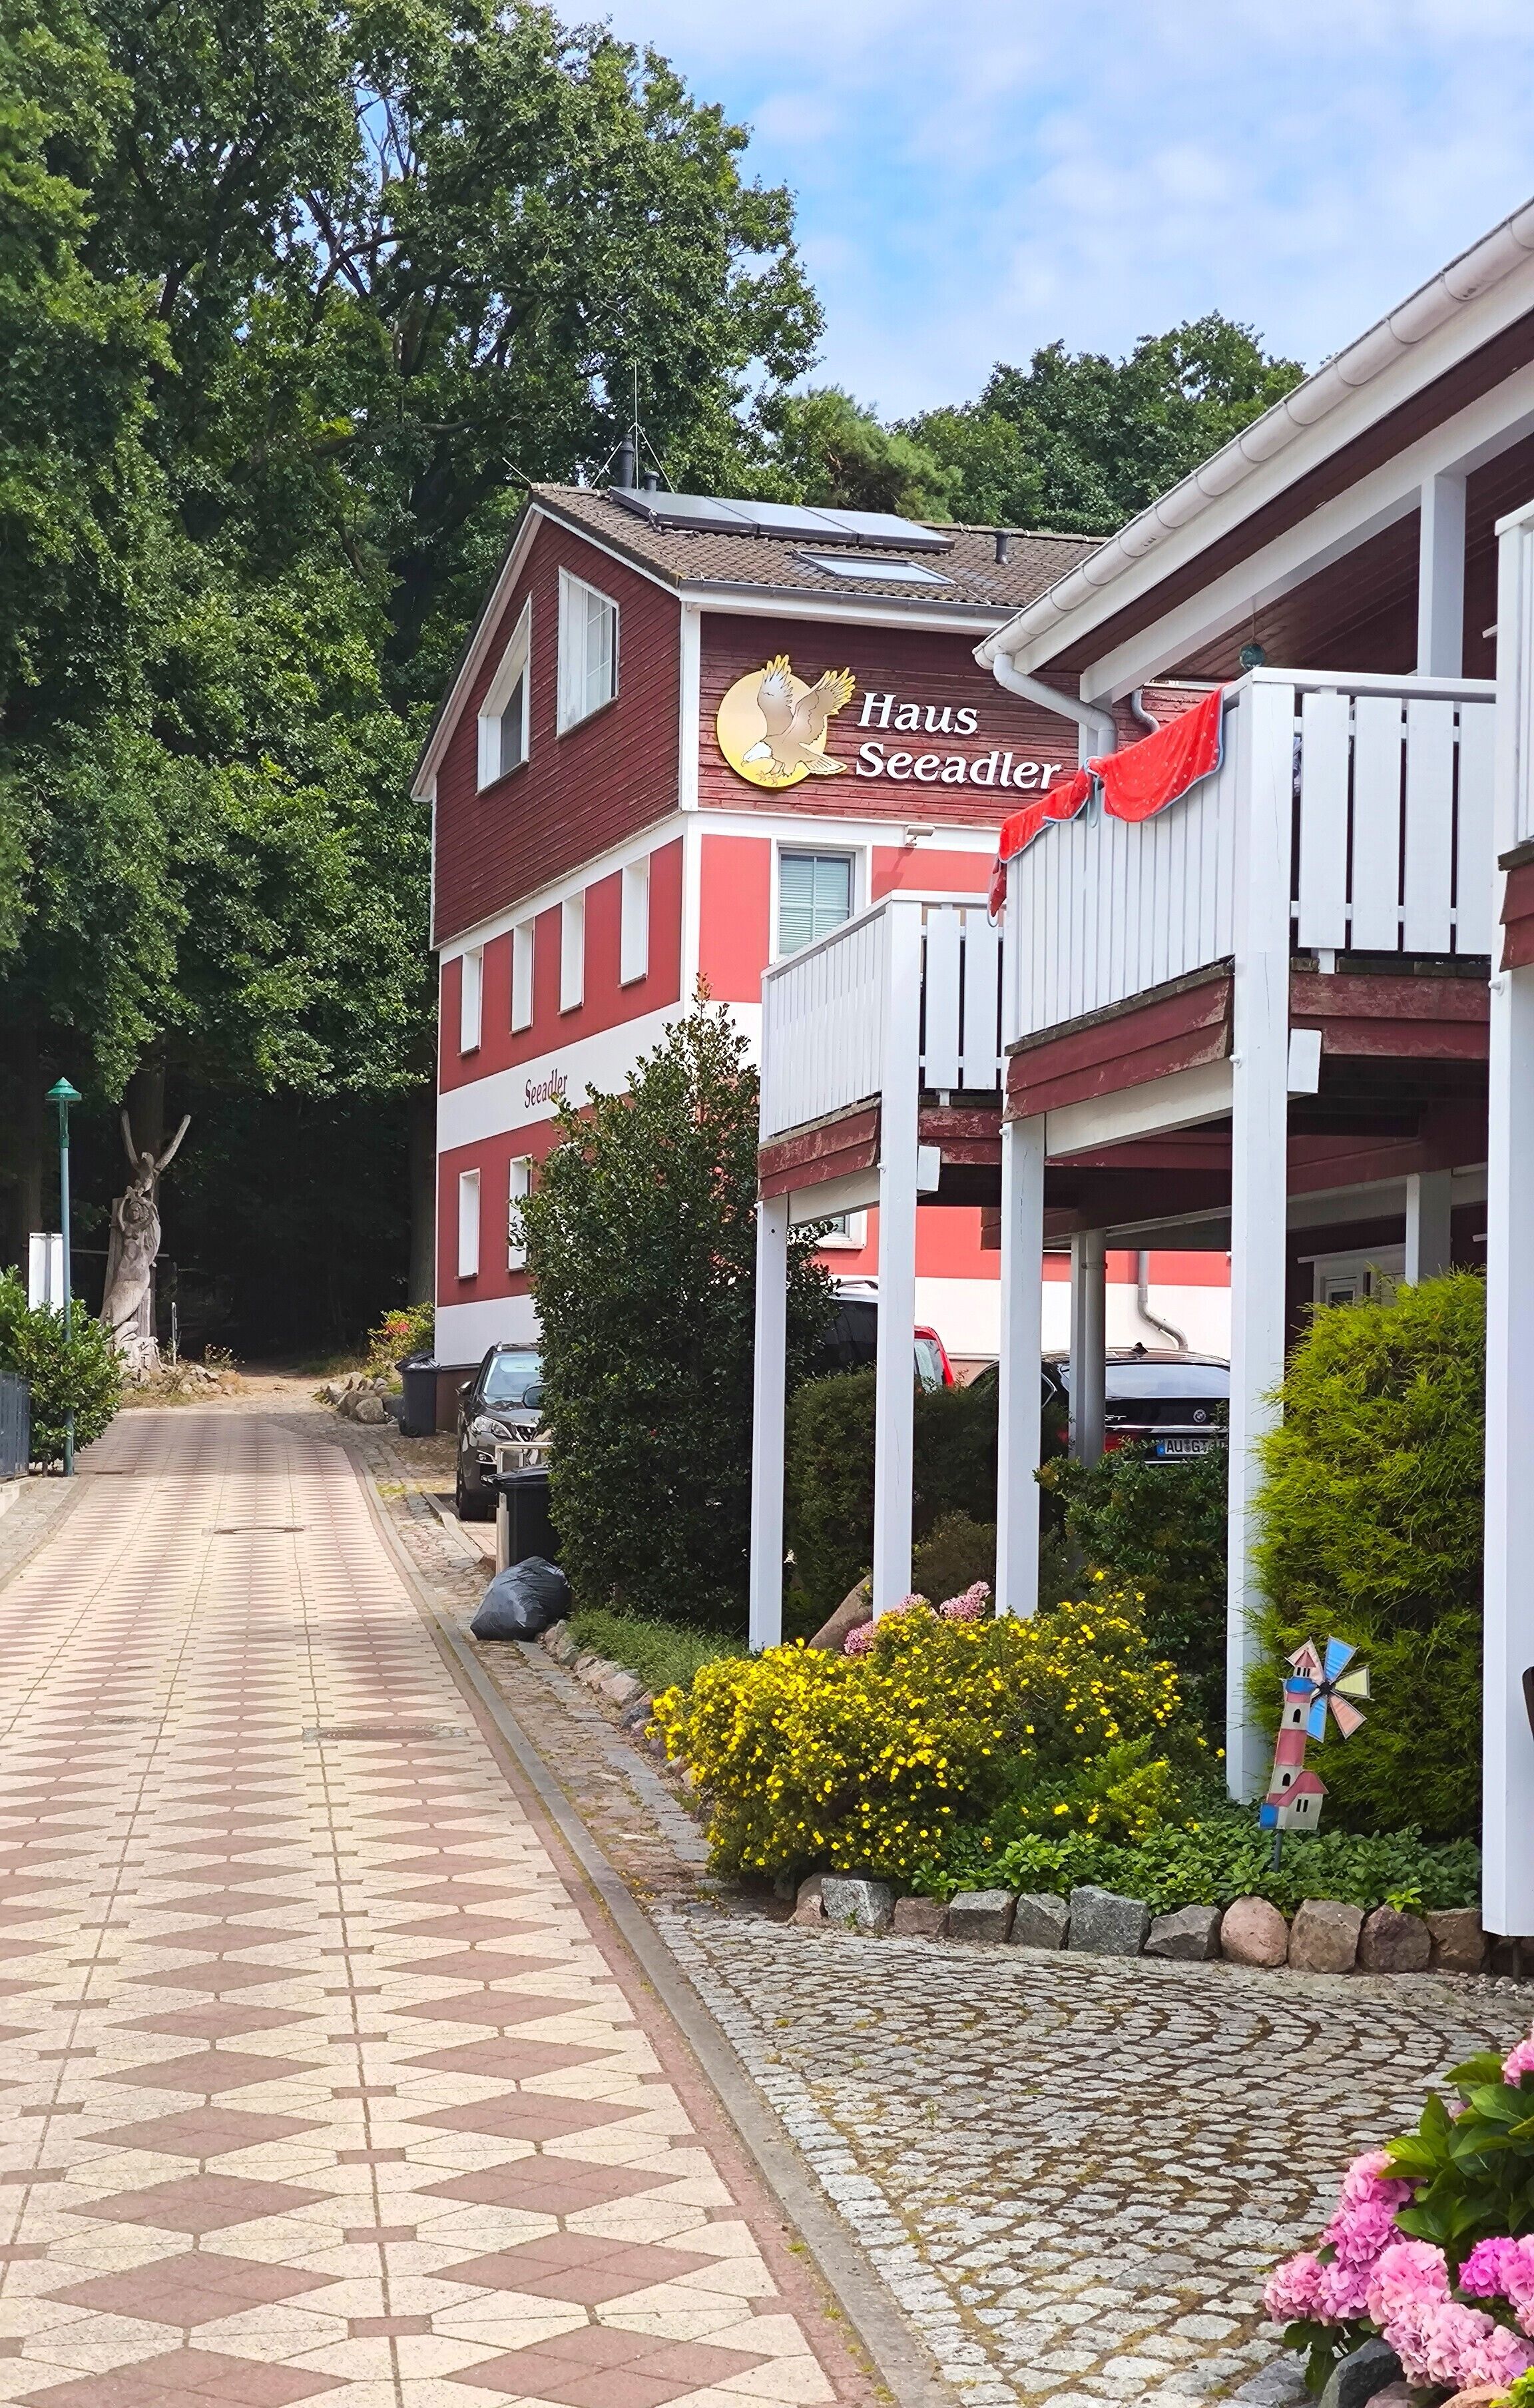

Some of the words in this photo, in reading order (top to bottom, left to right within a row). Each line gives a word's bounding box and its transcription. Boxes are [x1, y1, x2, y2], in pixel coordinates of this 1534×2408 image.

[857, 693, 979, 735] Haus
[856, 742, 1061, 790] Seeadler
[525, 1068, 567, 1108] Seeadler
[1166, 1440, 1183, 1453] AU
